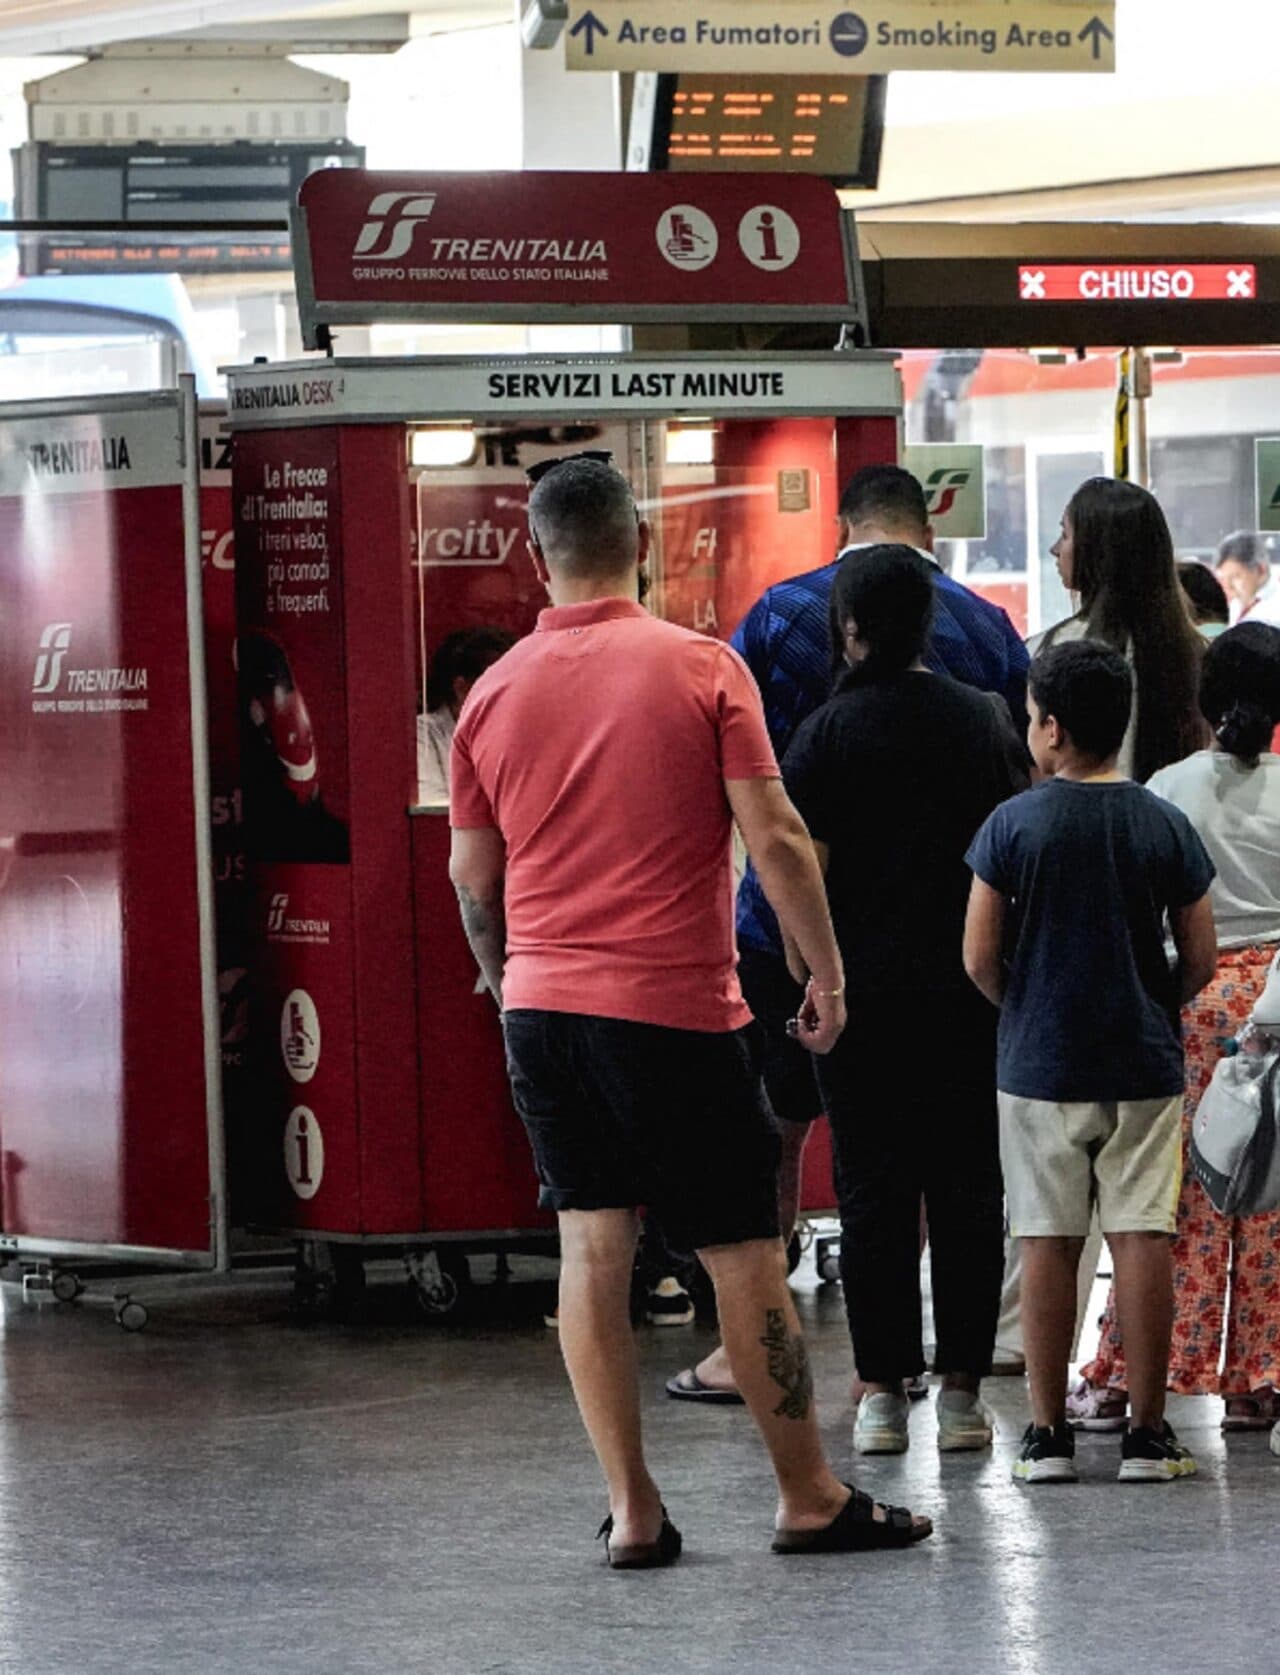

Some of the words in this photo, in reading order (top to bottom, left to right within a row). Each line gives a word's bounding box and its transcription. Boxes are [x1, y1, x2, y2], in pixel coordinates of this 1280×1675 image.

[617, 19, 687, 44] Area
[696, 20, 820, 45] Fumatori
[877, 20, 997, 54] Smoking
[1005, 23, 1071, 47] Area
[430, 239, 608, 261] TRENITALIA
[353, 268, 406, 281] GRUPPO
[409, 268, 468, 281] FERROVIE
[471, 269, 510, 281] DELLO
[513, 268, 550, 281] STATO
[554, 268, 609, 281] ITALIANE
[1079, 270, 1194, 298] CHIUSO
[303, 380, 334, 405] DESK
[488, 373, 601, 398] SERVIZI
[611, 374, 675, 397] LAST
[682, 372, 784, 396] MINUTE
[30, 437, 130, 474] TRENITALIA
[264, 463, 281, 488] Le
[283, 461, 328, 488] Frecce
[255, 491, 329, 520] Trenitalia:
[265, 527, 291, 551] treni
[267, 557, 285, 587] più
[287, 551, 330, 581] comodi
[68, 668, 148, 693] TRENITALIA
